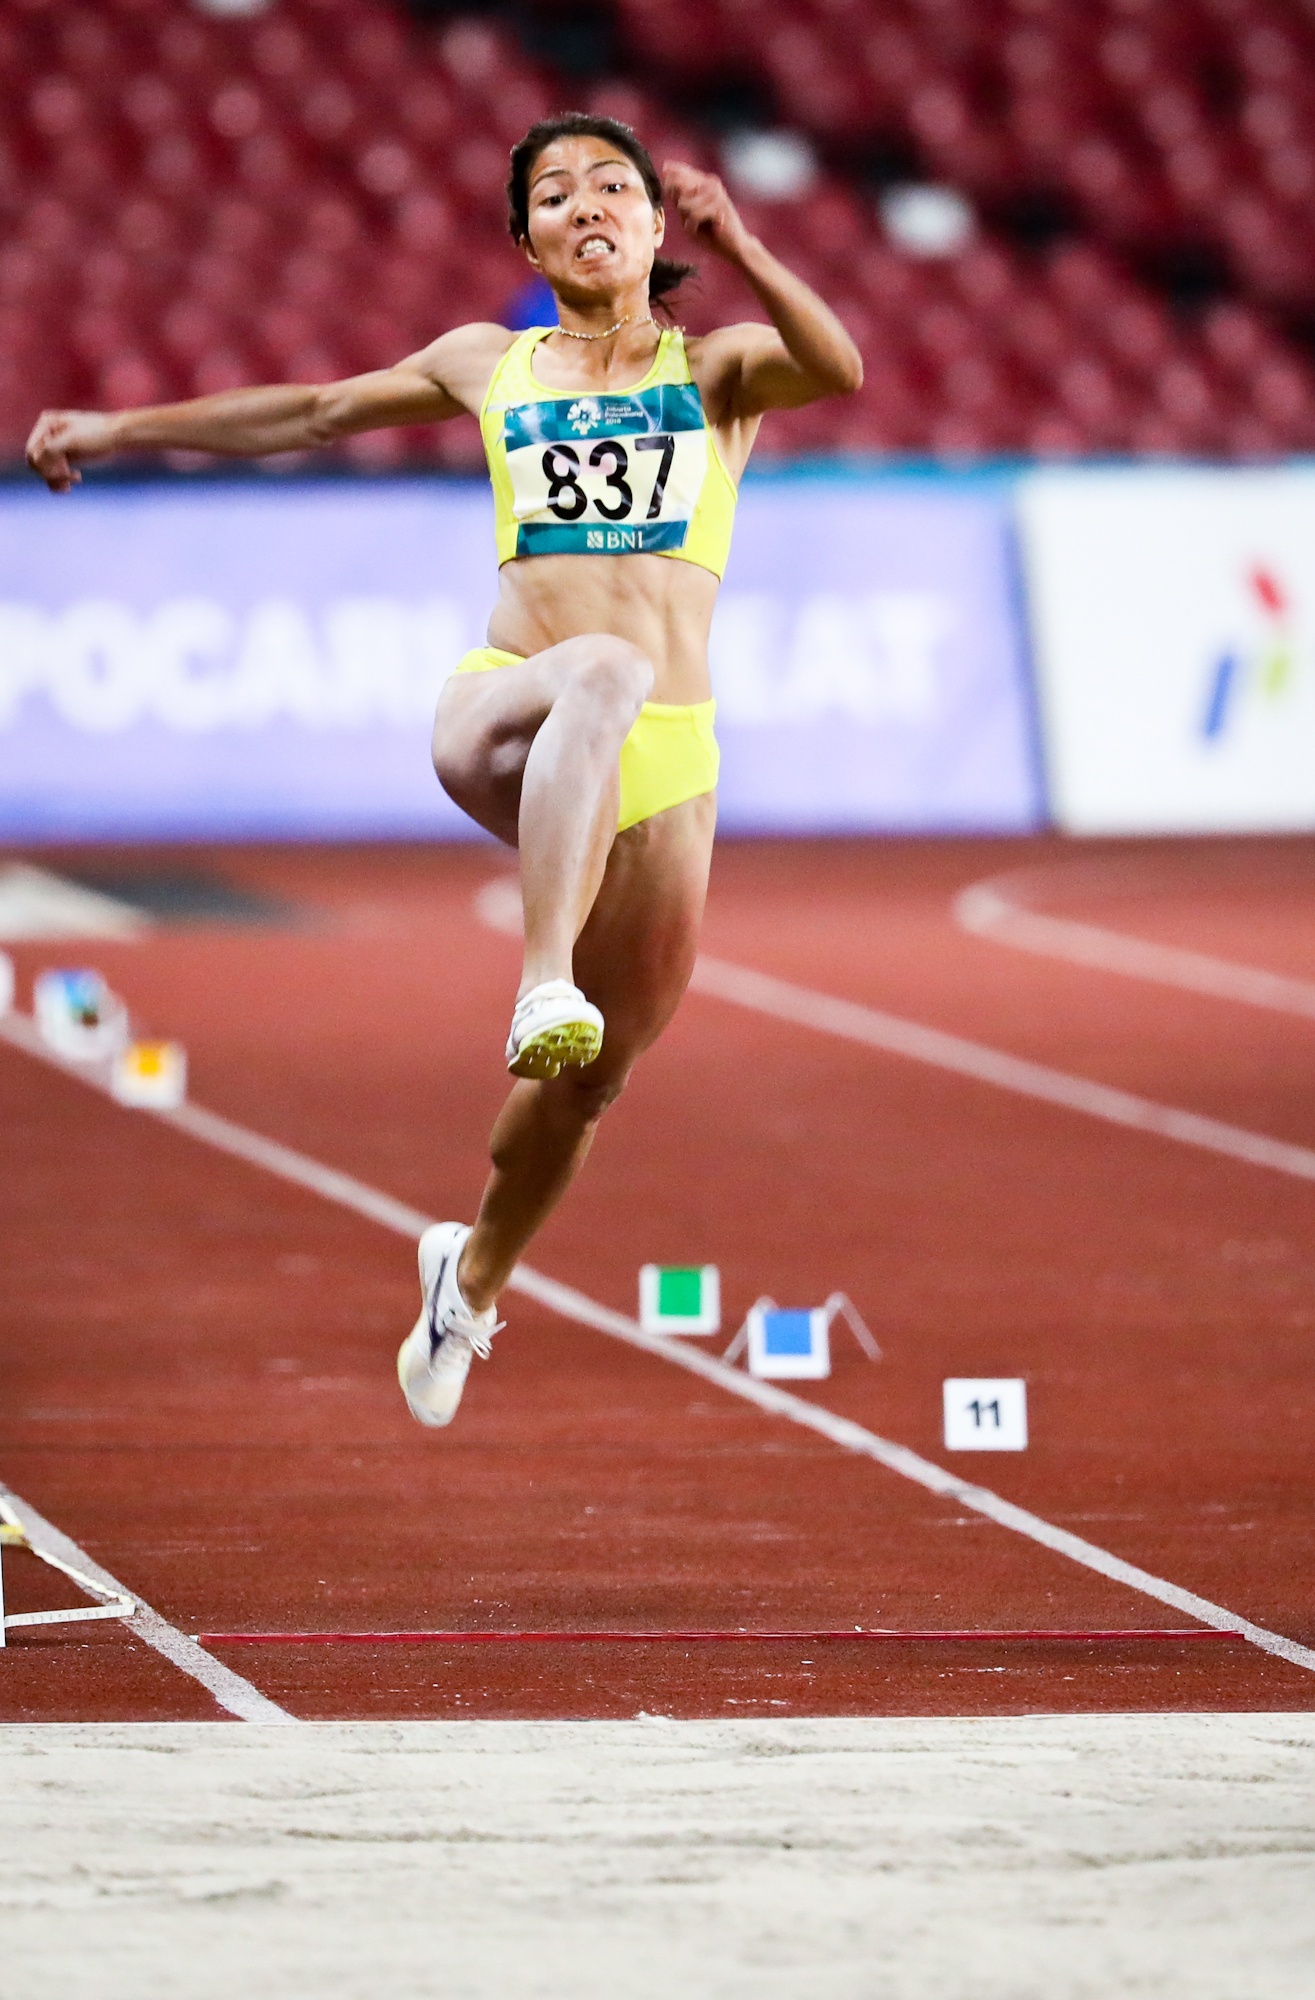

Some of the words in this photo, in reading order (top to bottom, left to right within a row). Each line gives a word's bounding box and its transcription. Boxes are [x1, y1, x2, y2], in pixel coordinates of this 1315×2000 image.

[541, 434, 676, 521] 837
[606, 531, 643, 549] BNI
[966, 1399, 1001, 1428] 11
